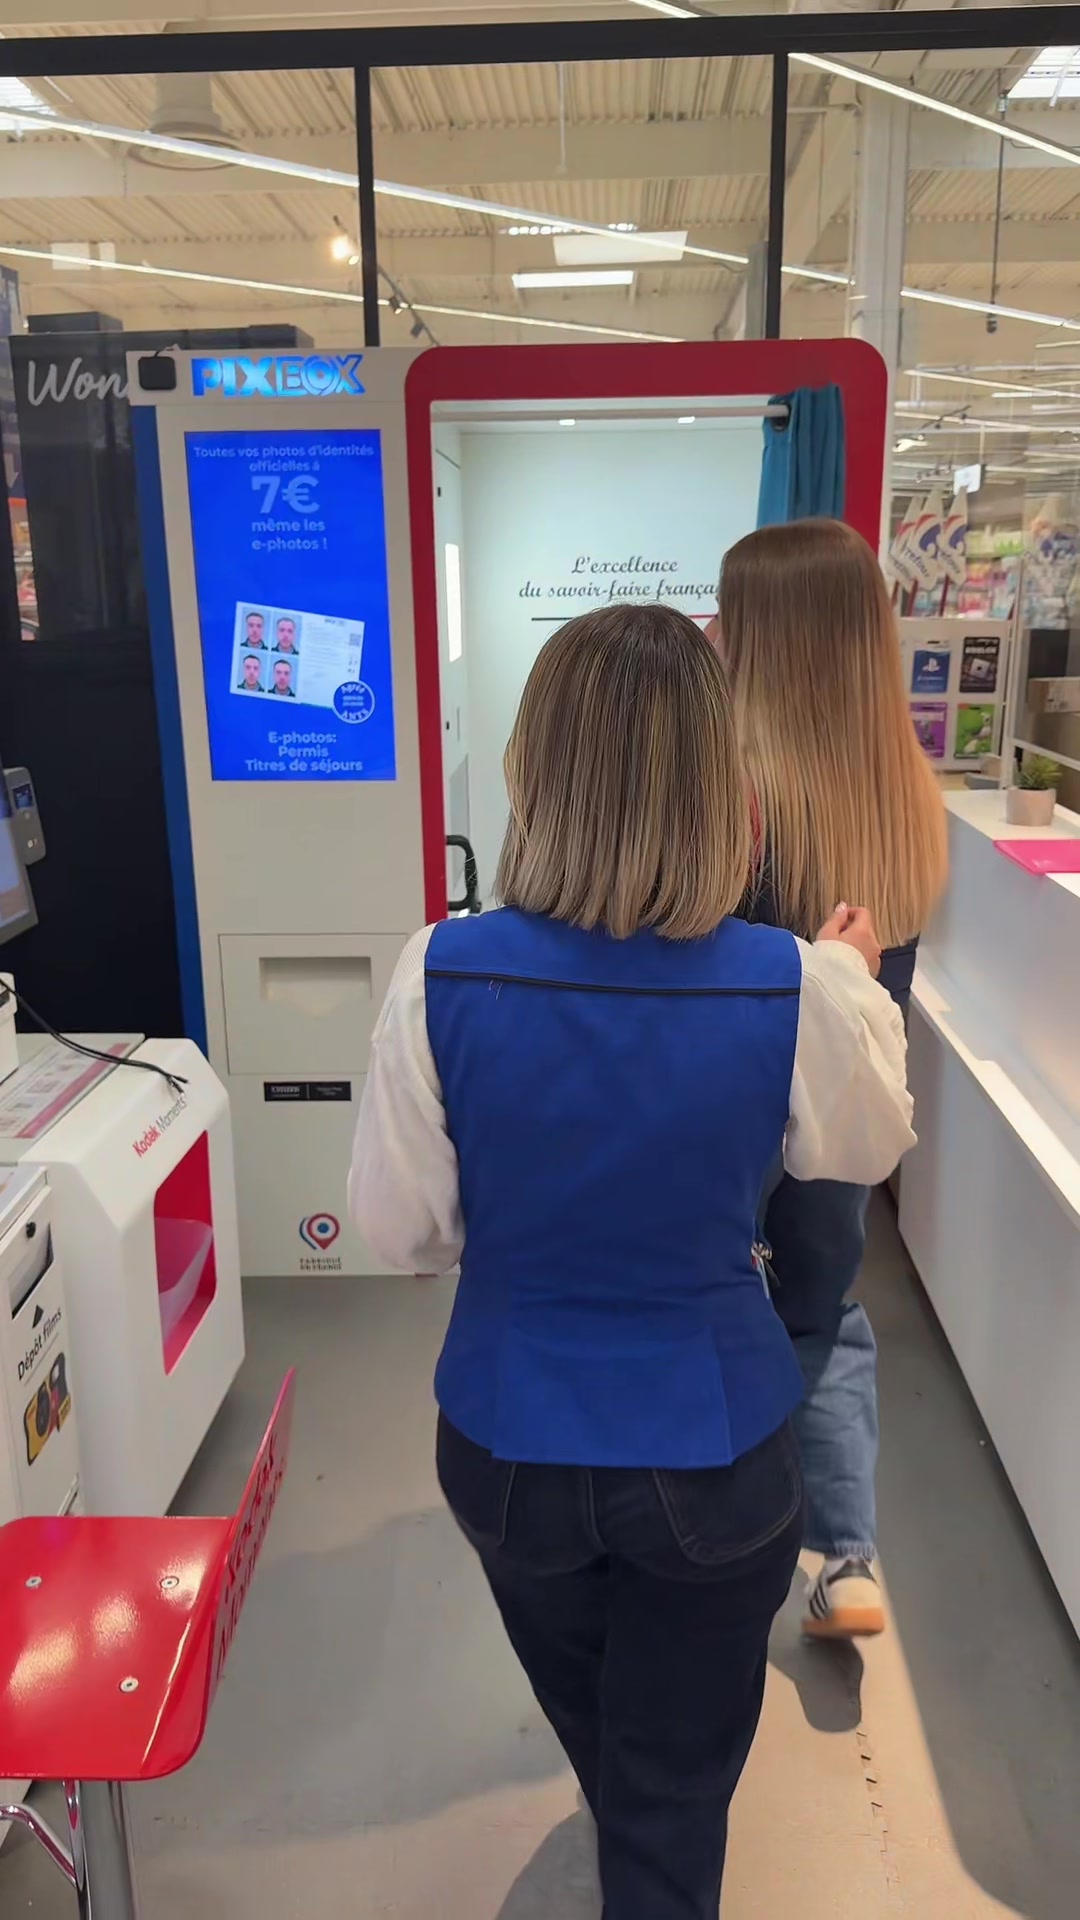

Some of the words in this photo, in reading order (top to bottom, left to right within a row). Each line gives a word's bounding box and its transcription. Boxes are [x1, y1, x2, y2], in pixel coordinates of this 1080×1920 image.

[28, 357, 129, 406] Won
[191, 354, 366, 396] PIXBOX
[194, 446, 236, 458] Toutes
[238, 447, 260, 458] vos
[262, 445, 306, 459] photos
[308, 444, 375, 457] d'identités
[249, 459, 310, 472] officielles
[312, 459, 320, 472] à
[251, 475, 320, 513] 7€
[251, 518, 300, 532] même
[304, 518, 326, 532] les
[251, 536, 320, 552] e-photos
[571, 555, 678, 575] L'excellence
[519, 581, 541, 598] du
[547, 579, 652, 601] savoir-faire
[655, 579, 719, 602] frança
[268, 731, 337, 746] E-photos:
[278, 744, 329, 757] Permis
[245, 758, 287, 771] Titres
[289, 758, 308, 771] de
[310, 758, 363, 774] séjours
[132, 1125, 161, 1157] Kodak
[155, 1096, 188, 1133] Moments
[17, 1334, 42, 1381] Dépôt
[43, 1308, 61, 1341] films
